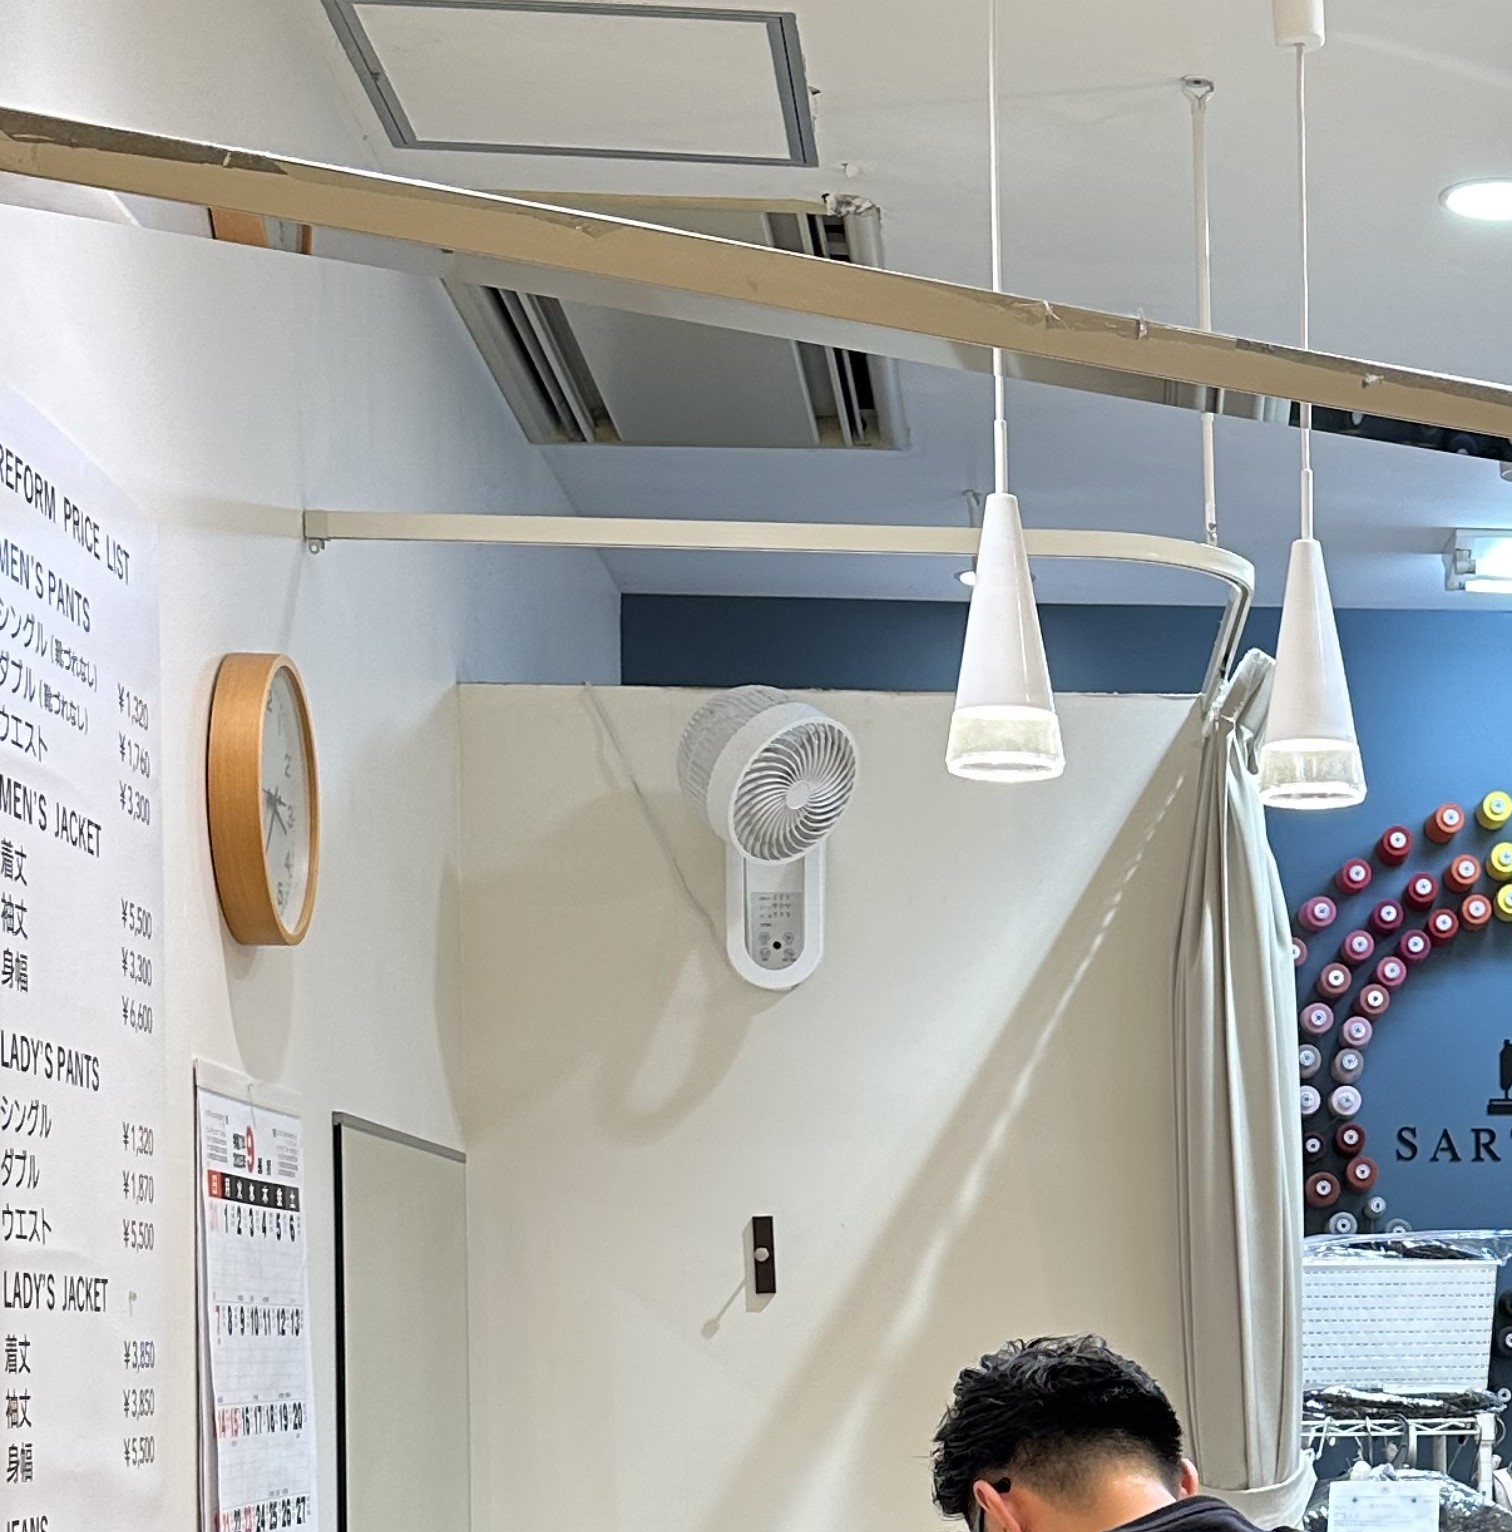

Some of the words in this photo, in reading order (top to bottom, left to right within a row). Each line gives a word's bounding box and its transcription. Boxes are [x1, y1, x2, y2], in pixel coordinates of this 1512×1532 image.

[64, 496, 100, 560] PRICE
[106, 534, 130, 585] LIST
[48, 570, 91, 632] PANTS
[0, 773, 47, 832] MEN'S
[55, 802, 102, 858] JACKET
[1, 837, 28, 887] 着丈
[1, 1030, 53, 1079] LADY'S
[57, 1045, 100, 1092] PANTS
[1, 1096, 51, 1138] シングル
[1, 1148, 40, 1189] ダブル
[2, 1203, 52, 1245] ウエスト
[123, 1219, 154, 1251] ¥5,500
[4, 1270, 55, 1310] LADY'S
[62, 1275, 108, 1312] JACKET
[5, 1334, 31, 1374] 着丈
